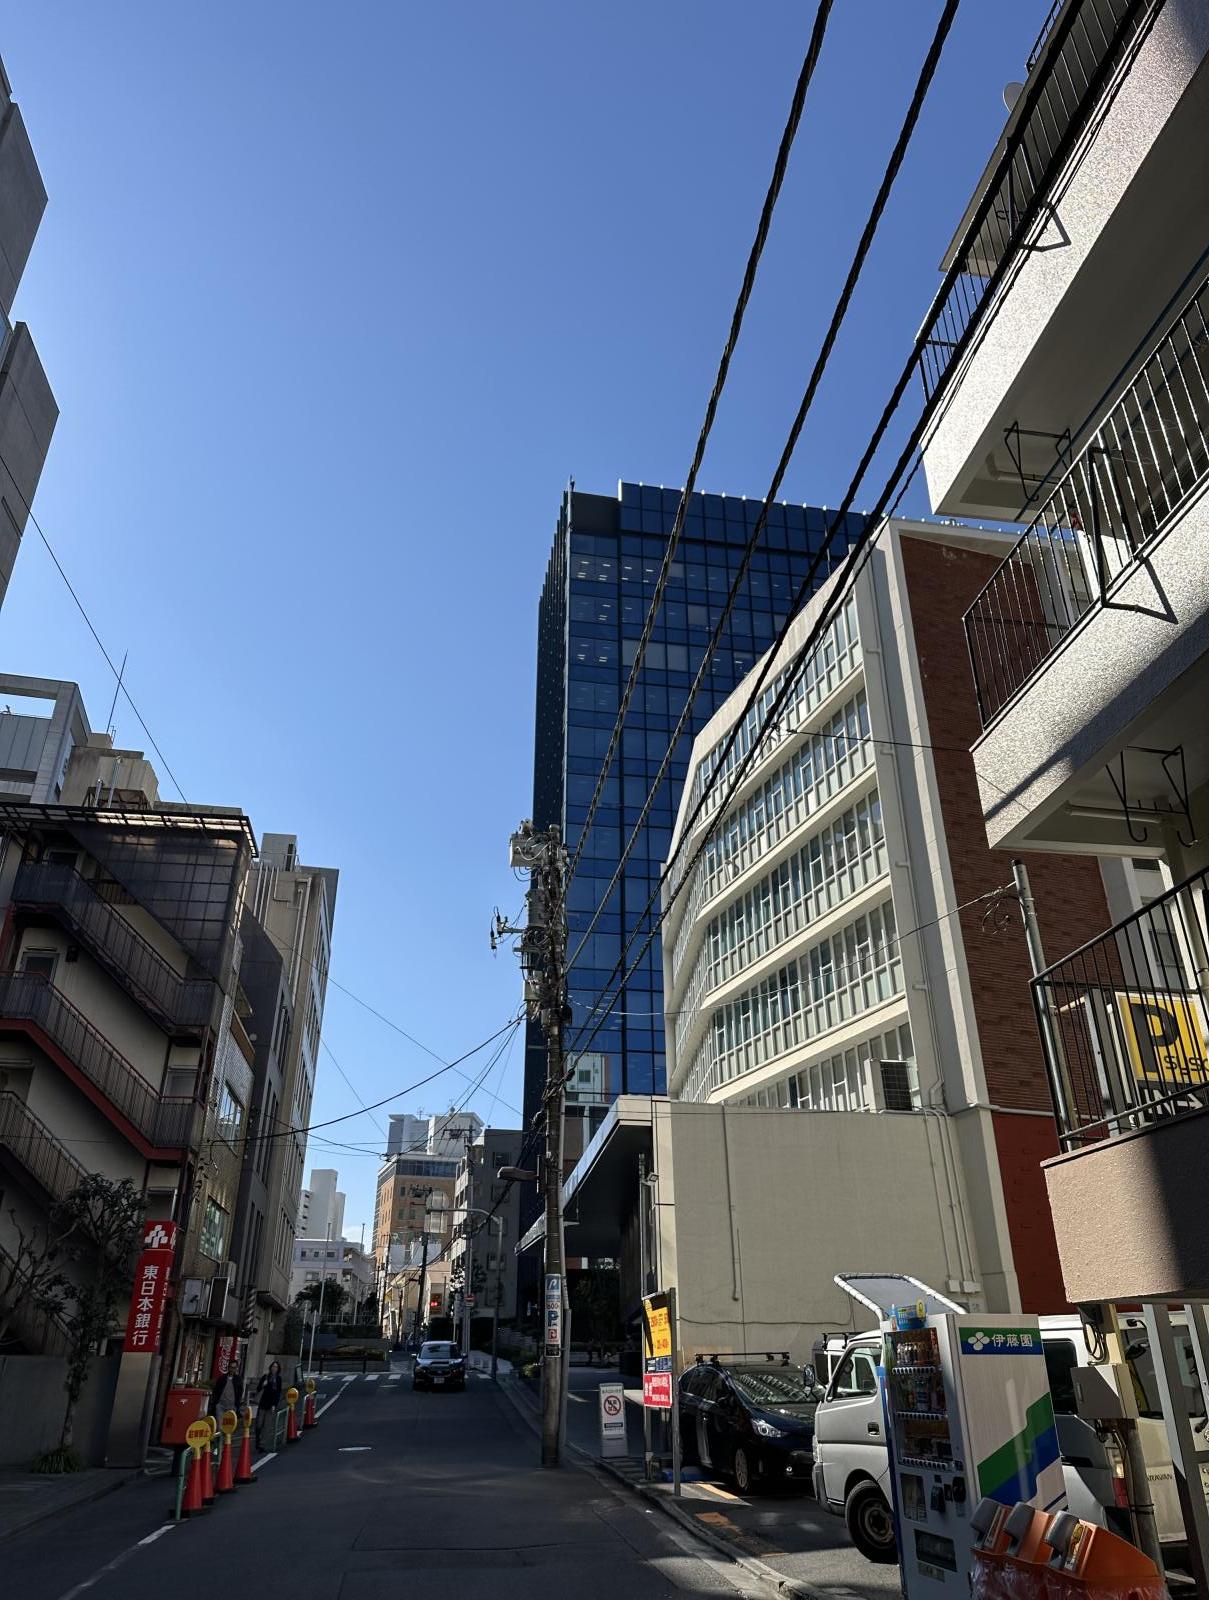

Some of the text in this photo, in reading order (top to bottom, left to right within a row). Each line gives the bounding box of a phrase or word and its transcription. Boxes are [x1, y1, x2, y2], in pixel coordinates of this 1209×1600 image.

[1131, 1003, 1180, 1073] P
[132, 1264, 160, 1346] 東日本銀行
[991, 1333, 1033, 1348] 伊藤園
